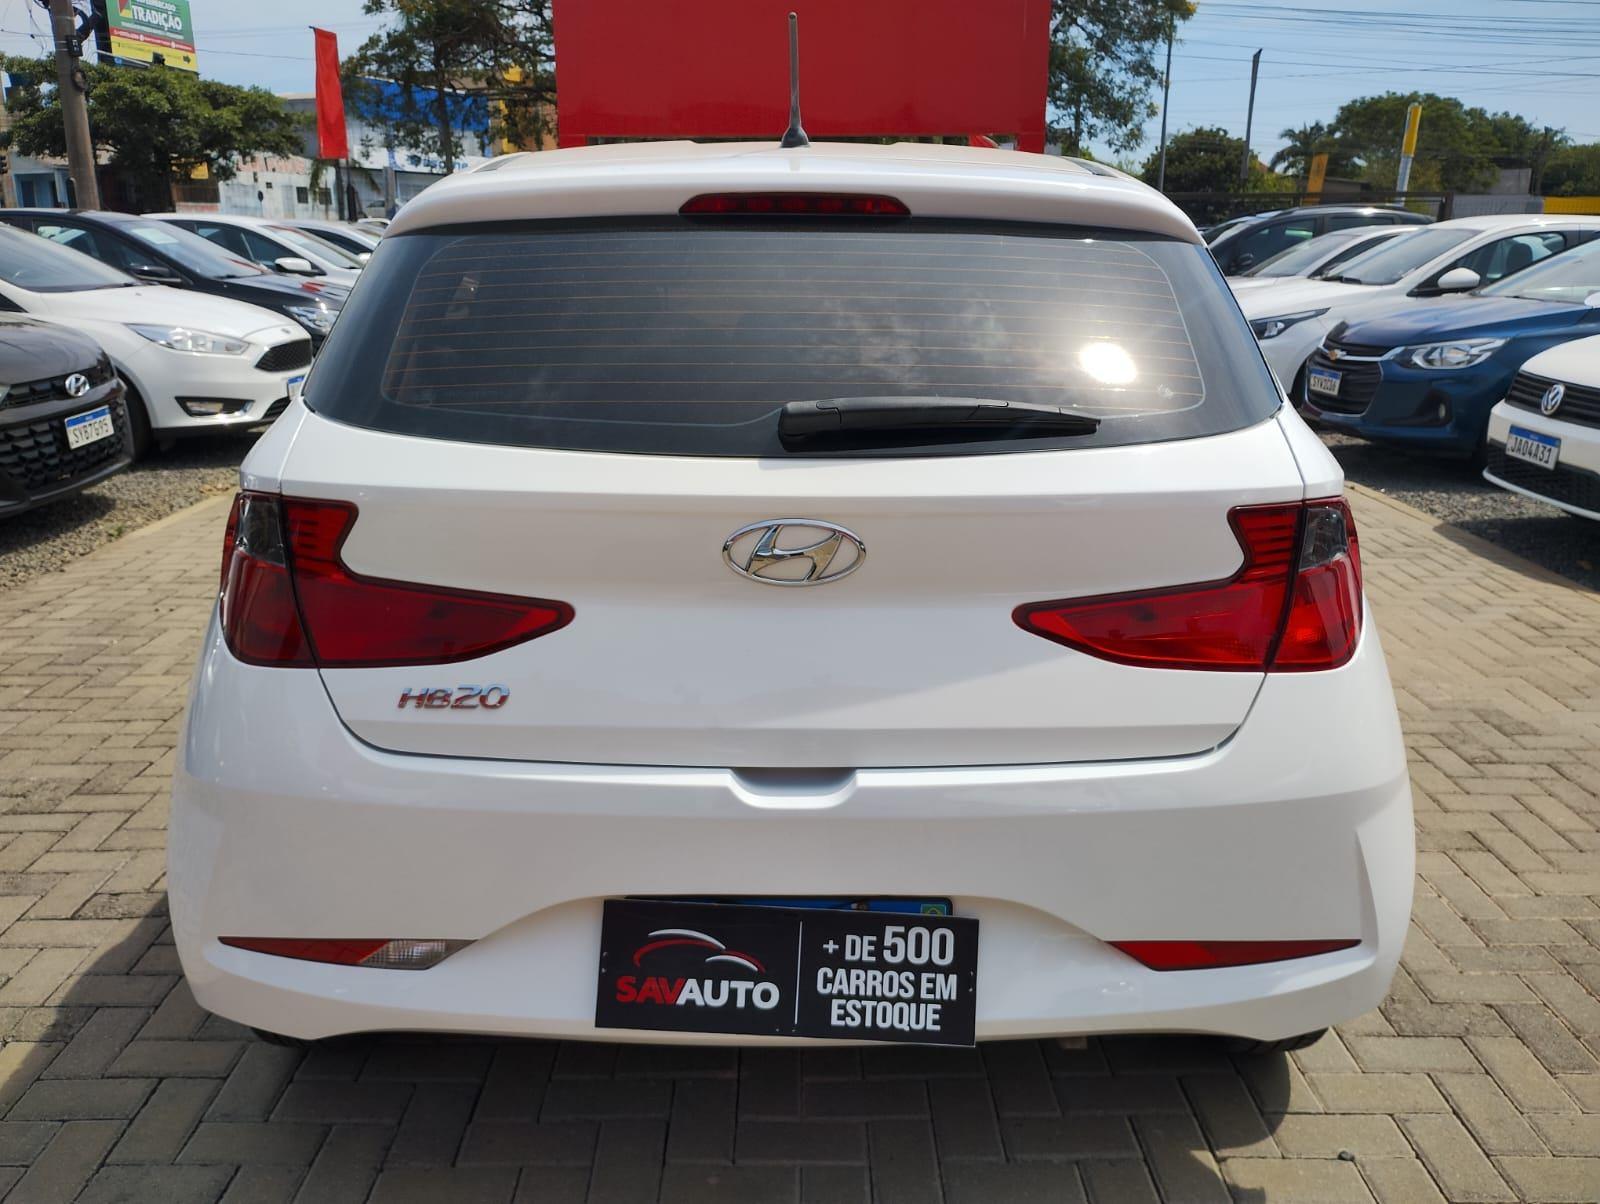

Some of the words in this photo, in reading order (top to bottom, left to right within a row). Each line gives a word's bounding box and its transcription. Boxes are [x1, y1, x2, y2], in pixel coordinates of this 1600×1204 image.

[132, 5, 183, 30] TRADIÇÃO
[398, 684, 510, 709] HB20
[845, 934, 877, 961] DE
[883, 925, 955, 966] 500
[616, 975, 780, 1010] SAVAUTO
[816, 967, 915, 998] CARROS
[920, 973, 957, 1000] EM
[830, 999, 942, 1031] ESTOQUE
